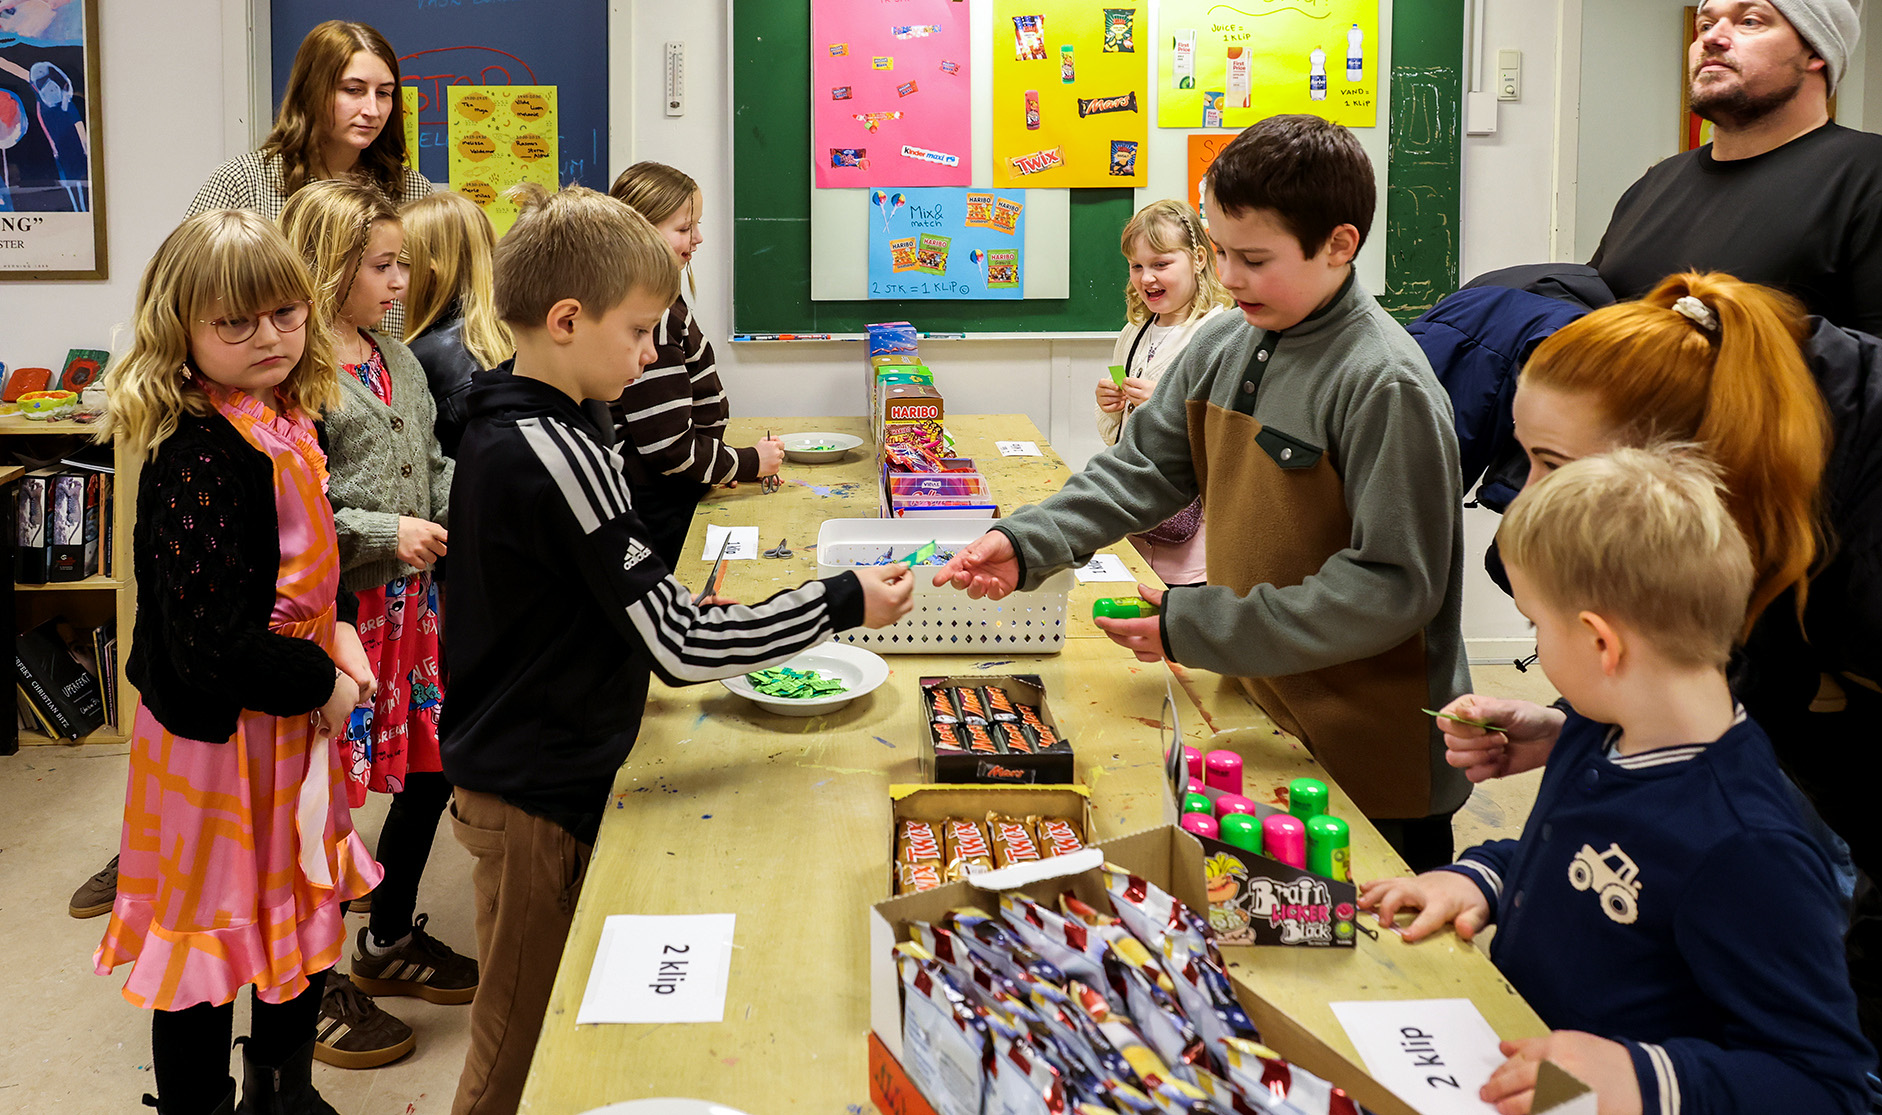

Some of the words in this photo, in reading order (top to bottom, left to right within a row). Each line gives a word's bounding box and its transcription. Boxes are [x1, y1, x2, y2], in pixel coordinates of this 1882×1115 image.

[1086, 94, 1130, 115] Mars
[926, 152, 945, 161] maxi
[968, 196, 991, 204] HARIBO
[998, 201, 1020, 212] HARIBO
[911, 220, 943, 228] match
[892, 240, 914, 249] HARIBO
[923, 238, 948, 248] HARIBO
[991, 253, 1015, 261] HARIBO
[872, 282, 880, 294] 2
[885, 284, 907, 294] STK
[922, 282, 930, 294] 1
[891, 405, 939, 420] HARIBO
[31, 680, 59, 714] CHRISTIAN
[56, 712, 70, 729] BITZ
[987, 765, 1025, 778] Mars
[1251, 879, 1329, 916] Brain
[1271, 903, 1330, 926] LICKER
[1283, 919, 1330, 942] Black
[662, 944, 690, 955] 2
[648, 961, 689, 995] klip
[1400, 1027, 1446, 1067] klip
[1426, 1075, 1461, 1089] 2
